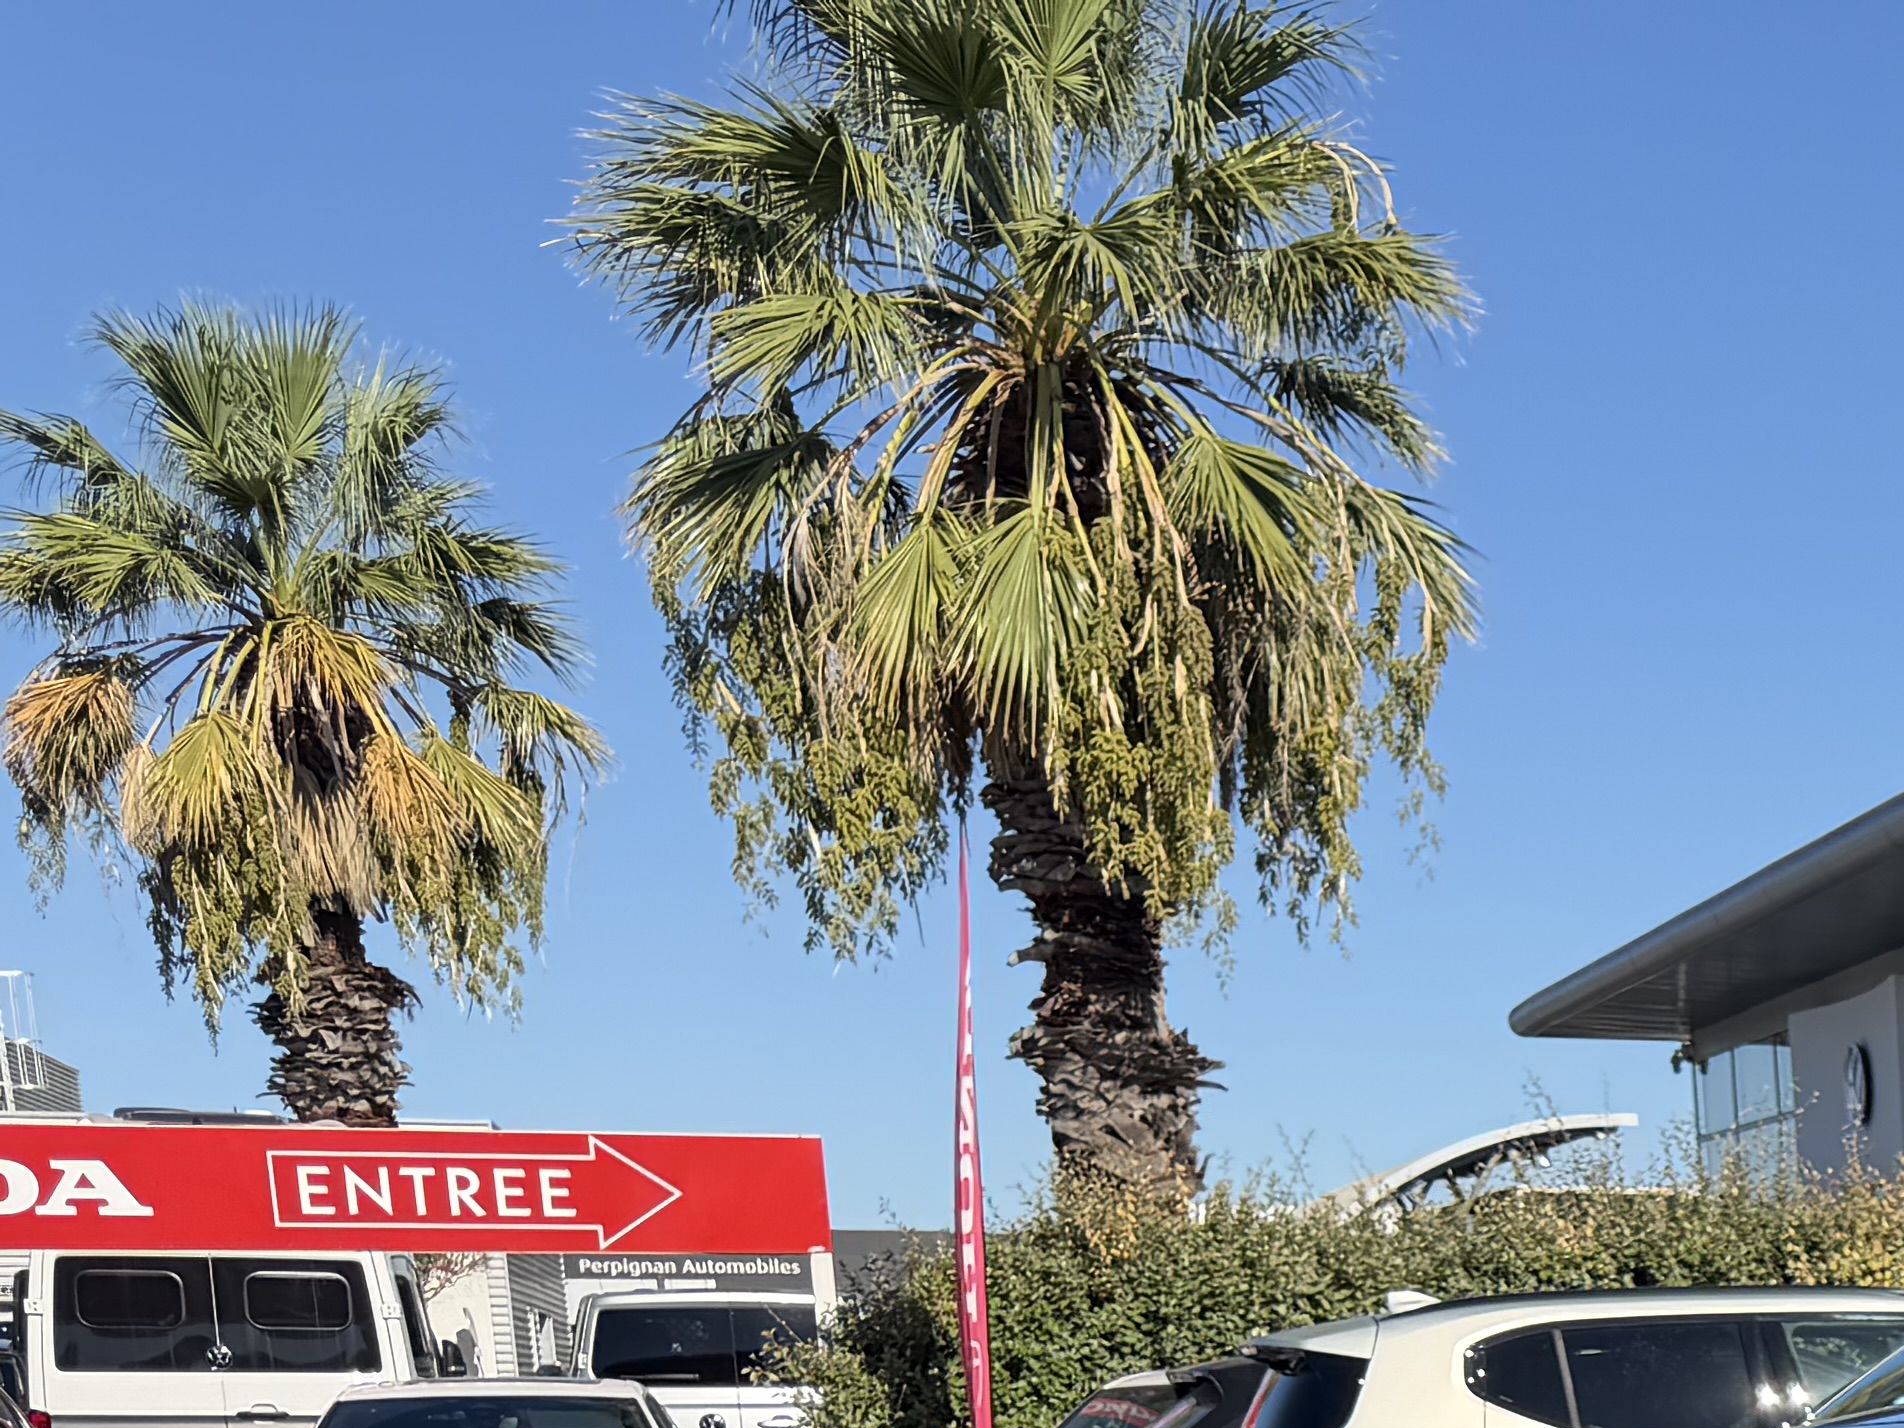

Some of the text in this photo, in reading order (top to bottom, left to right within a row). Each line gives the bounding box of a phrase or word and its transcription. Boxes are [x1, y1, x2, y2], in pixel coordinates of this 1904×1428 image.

[296, 1165, 577, 1218] ENTREE
[579, 1257, 801, 1277] Perpignan Automobiles
